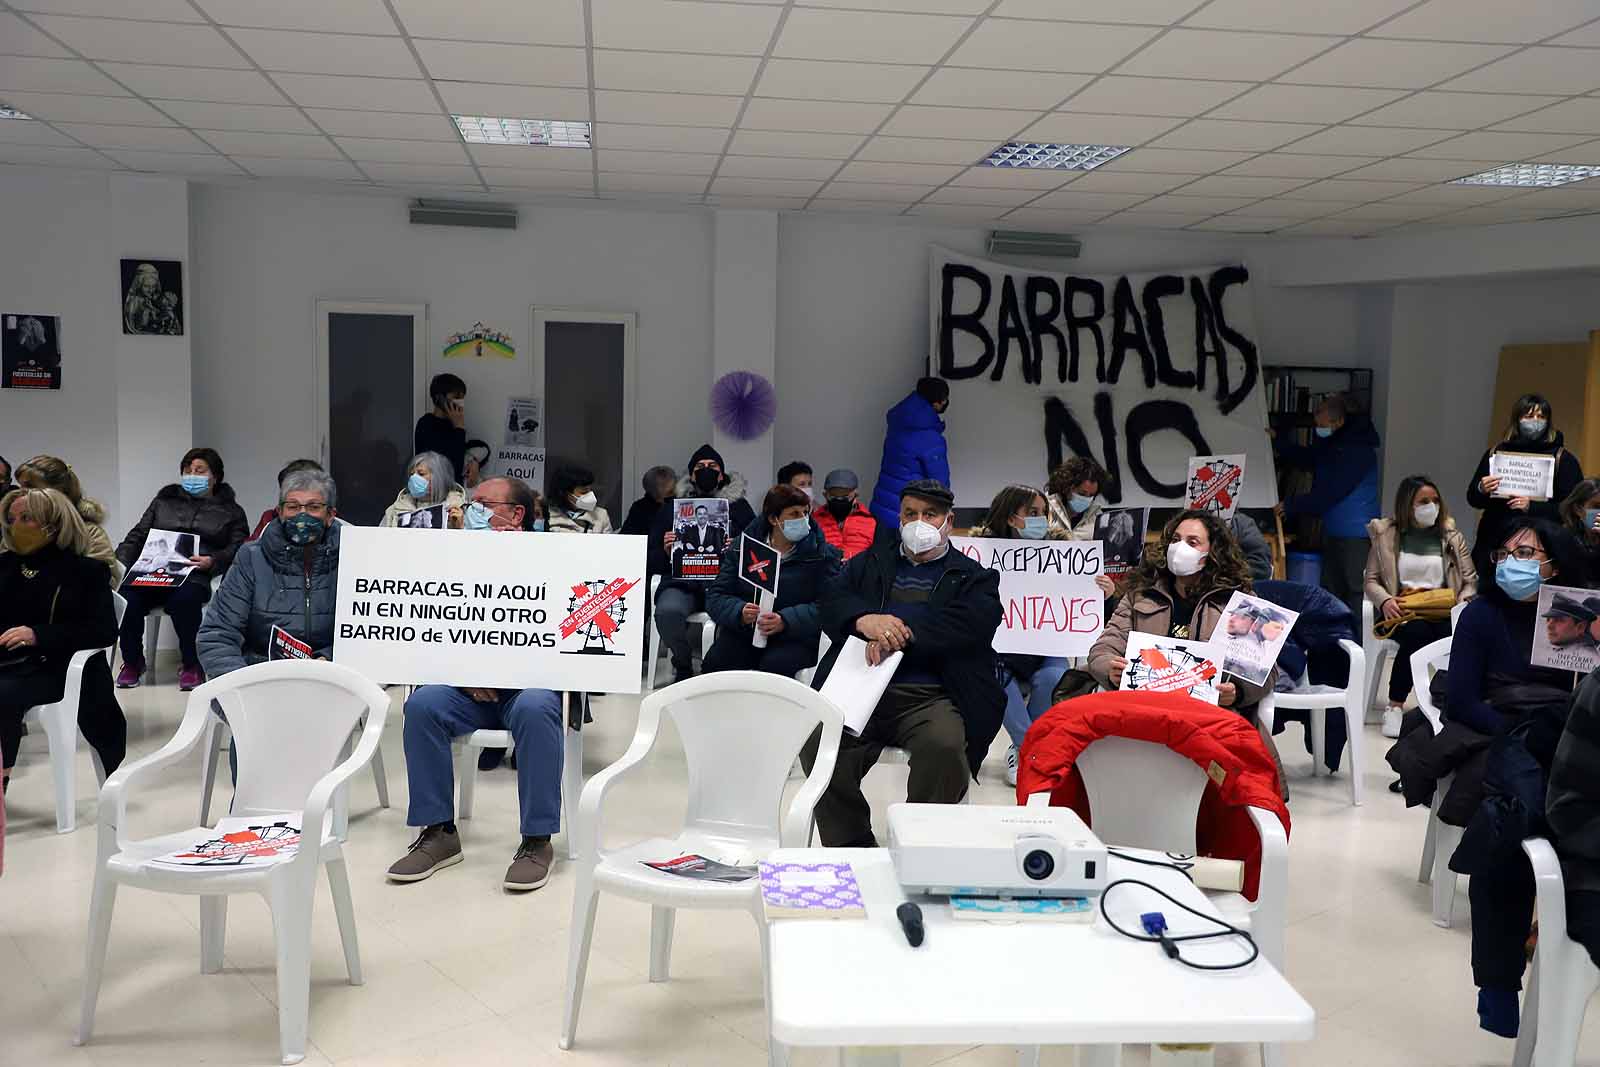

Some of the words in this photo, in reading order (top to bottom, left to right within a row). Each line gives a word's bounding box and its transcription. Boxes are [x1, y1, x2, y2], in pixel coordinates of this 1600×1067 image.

[938, 263, 1259, 415] BARRACAS
[499, 451, 544, 462] BARRACAS
[1044, 392, 1213, 504] NO
[506, 467, 536, 479] AQUÍ
[990, 545, 1100, 575] ACEPTAMOS
[474, 583, 492, 599] NI
[497, 582, 547, 600] AQUÍ
[579, 590, 594, 604] NO
[352, 601, 370, 616] NI
[376, 602, 403, 618] EN
[410, 602, 486, 622] NINGÚN
[491, 607, 547, 624] OTRO
[563, 617, 574, 627] EN
[573, 580, 621, 620] FUENTECILLAS
[340, 623, 416, 642] BARRIO
[421, 628, 443, 643] de
[448, 628, 556, 648] VIVIENDAS
[1158, 666, 1175, 679] NO
